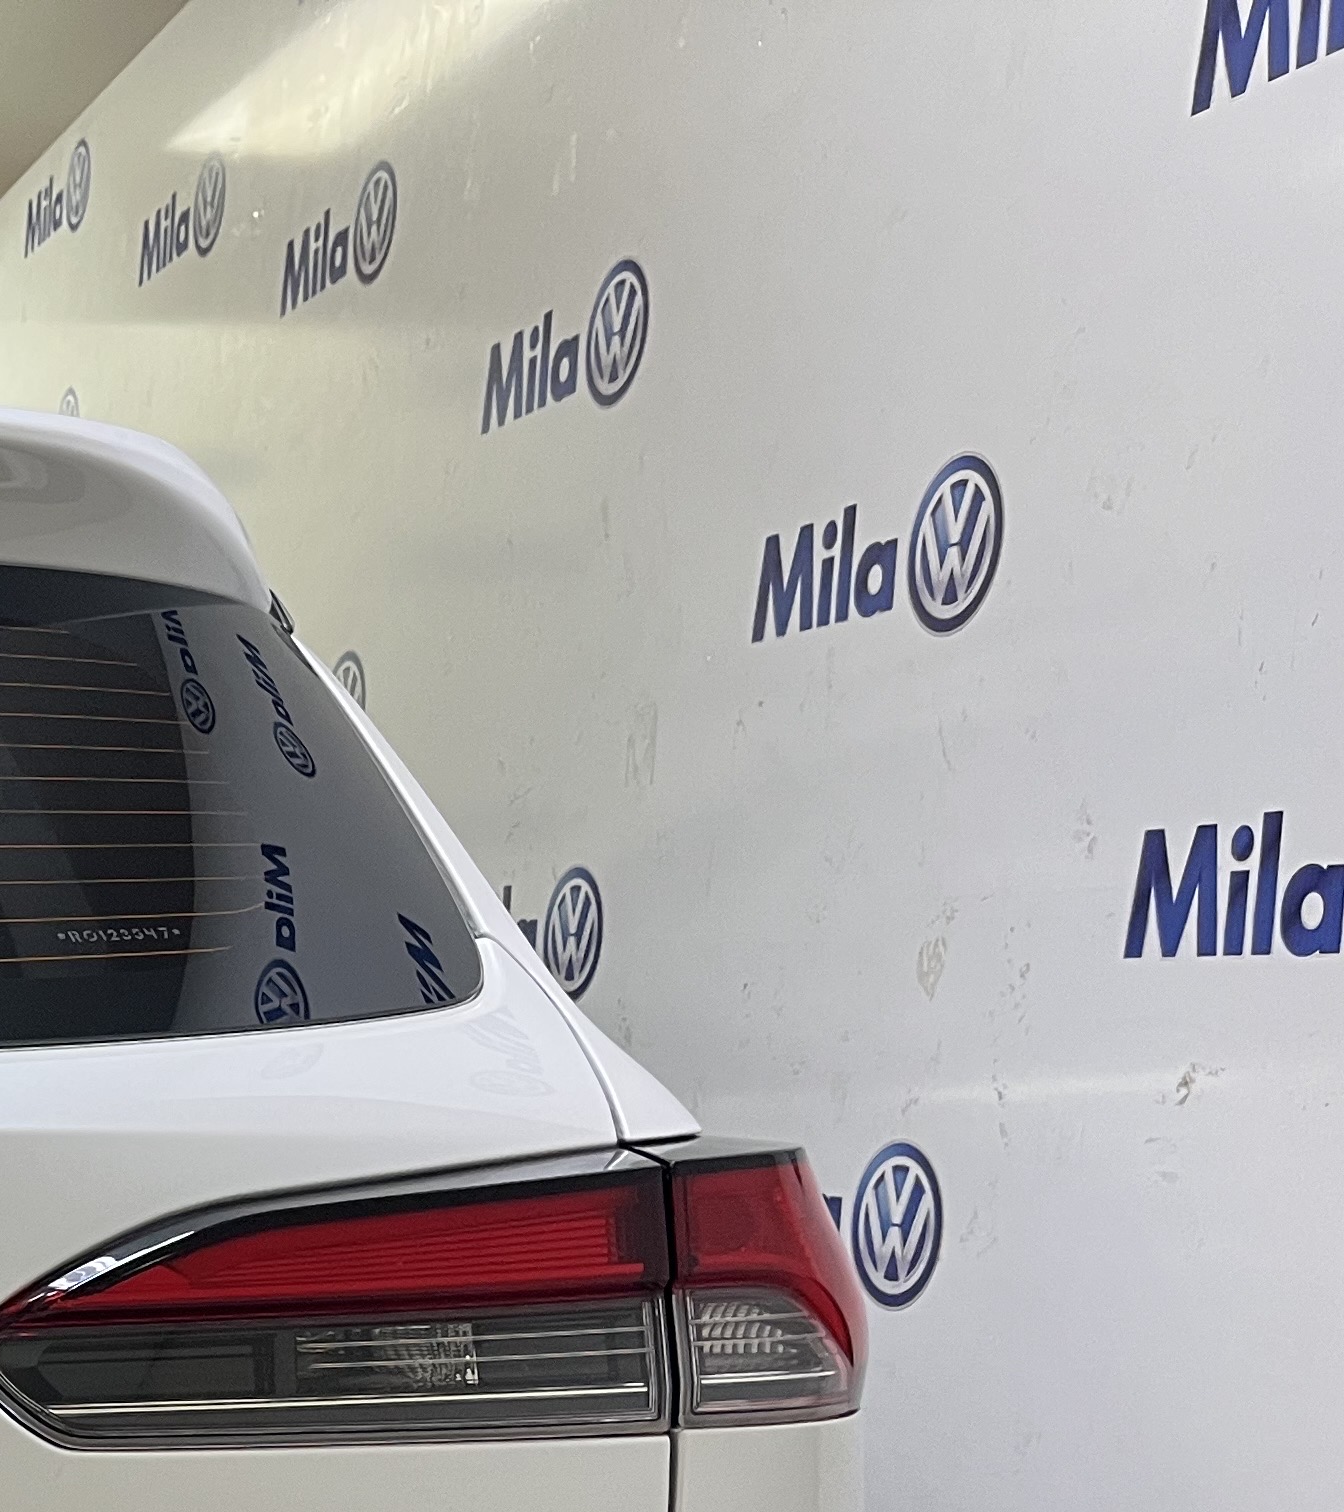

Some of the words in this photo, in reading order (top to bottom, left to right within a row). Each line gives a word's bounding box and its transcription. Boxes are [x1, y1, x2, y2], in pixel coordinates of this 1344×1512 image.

[24, 176, 64, 258] Mila
[138, 192, 190, 287] Mila
[280, 210, 350, 318] Mila
[481, 309, 580, 435] Mila
[752, 503, 898, 644] Mila
[1123, 810, 1344, 959] Mila
